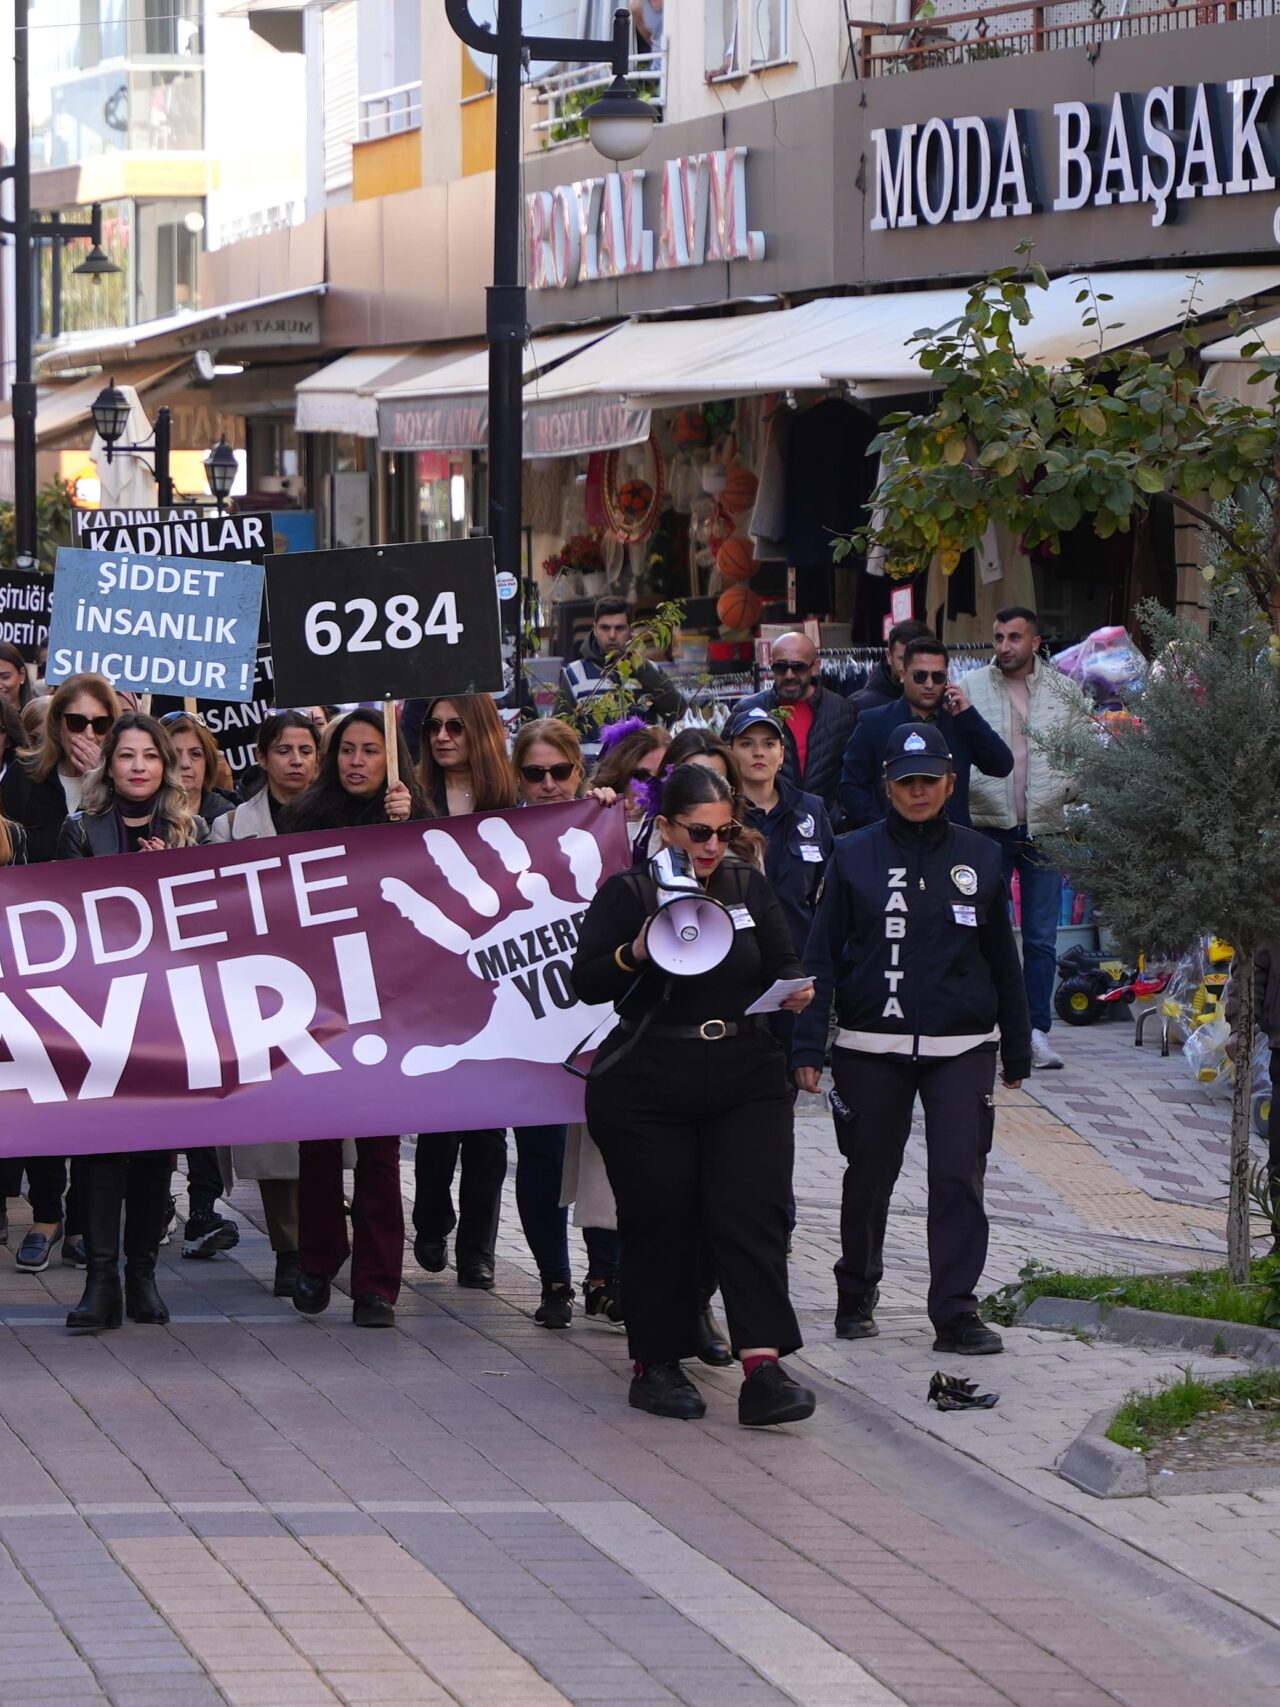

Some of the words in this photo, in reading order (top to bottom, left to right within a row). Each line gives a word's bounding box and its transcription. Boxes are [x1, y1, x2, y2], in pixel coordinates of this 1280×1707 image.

[870, 108, 1032, 230] MODA
[1053, 74, 1276, 227] BAŞAK
[526, 169, 654, 289] ROYAL
[538, 410, 593, 451] ROYAL
[89, 516, 266, 557] KADINLAR
[97, 557, 224, 595] ŞİDDET
[75, 598, 238, 644] İNSANLIK
[304, 591, 464, 656] 6284
[53, 648, 226, 690] SUÇUDUR
[474, 908, 587, 981] MAZERE
[882, 867, 909, 1019] ZABITA
[511, 960, 579, 1020] YO
